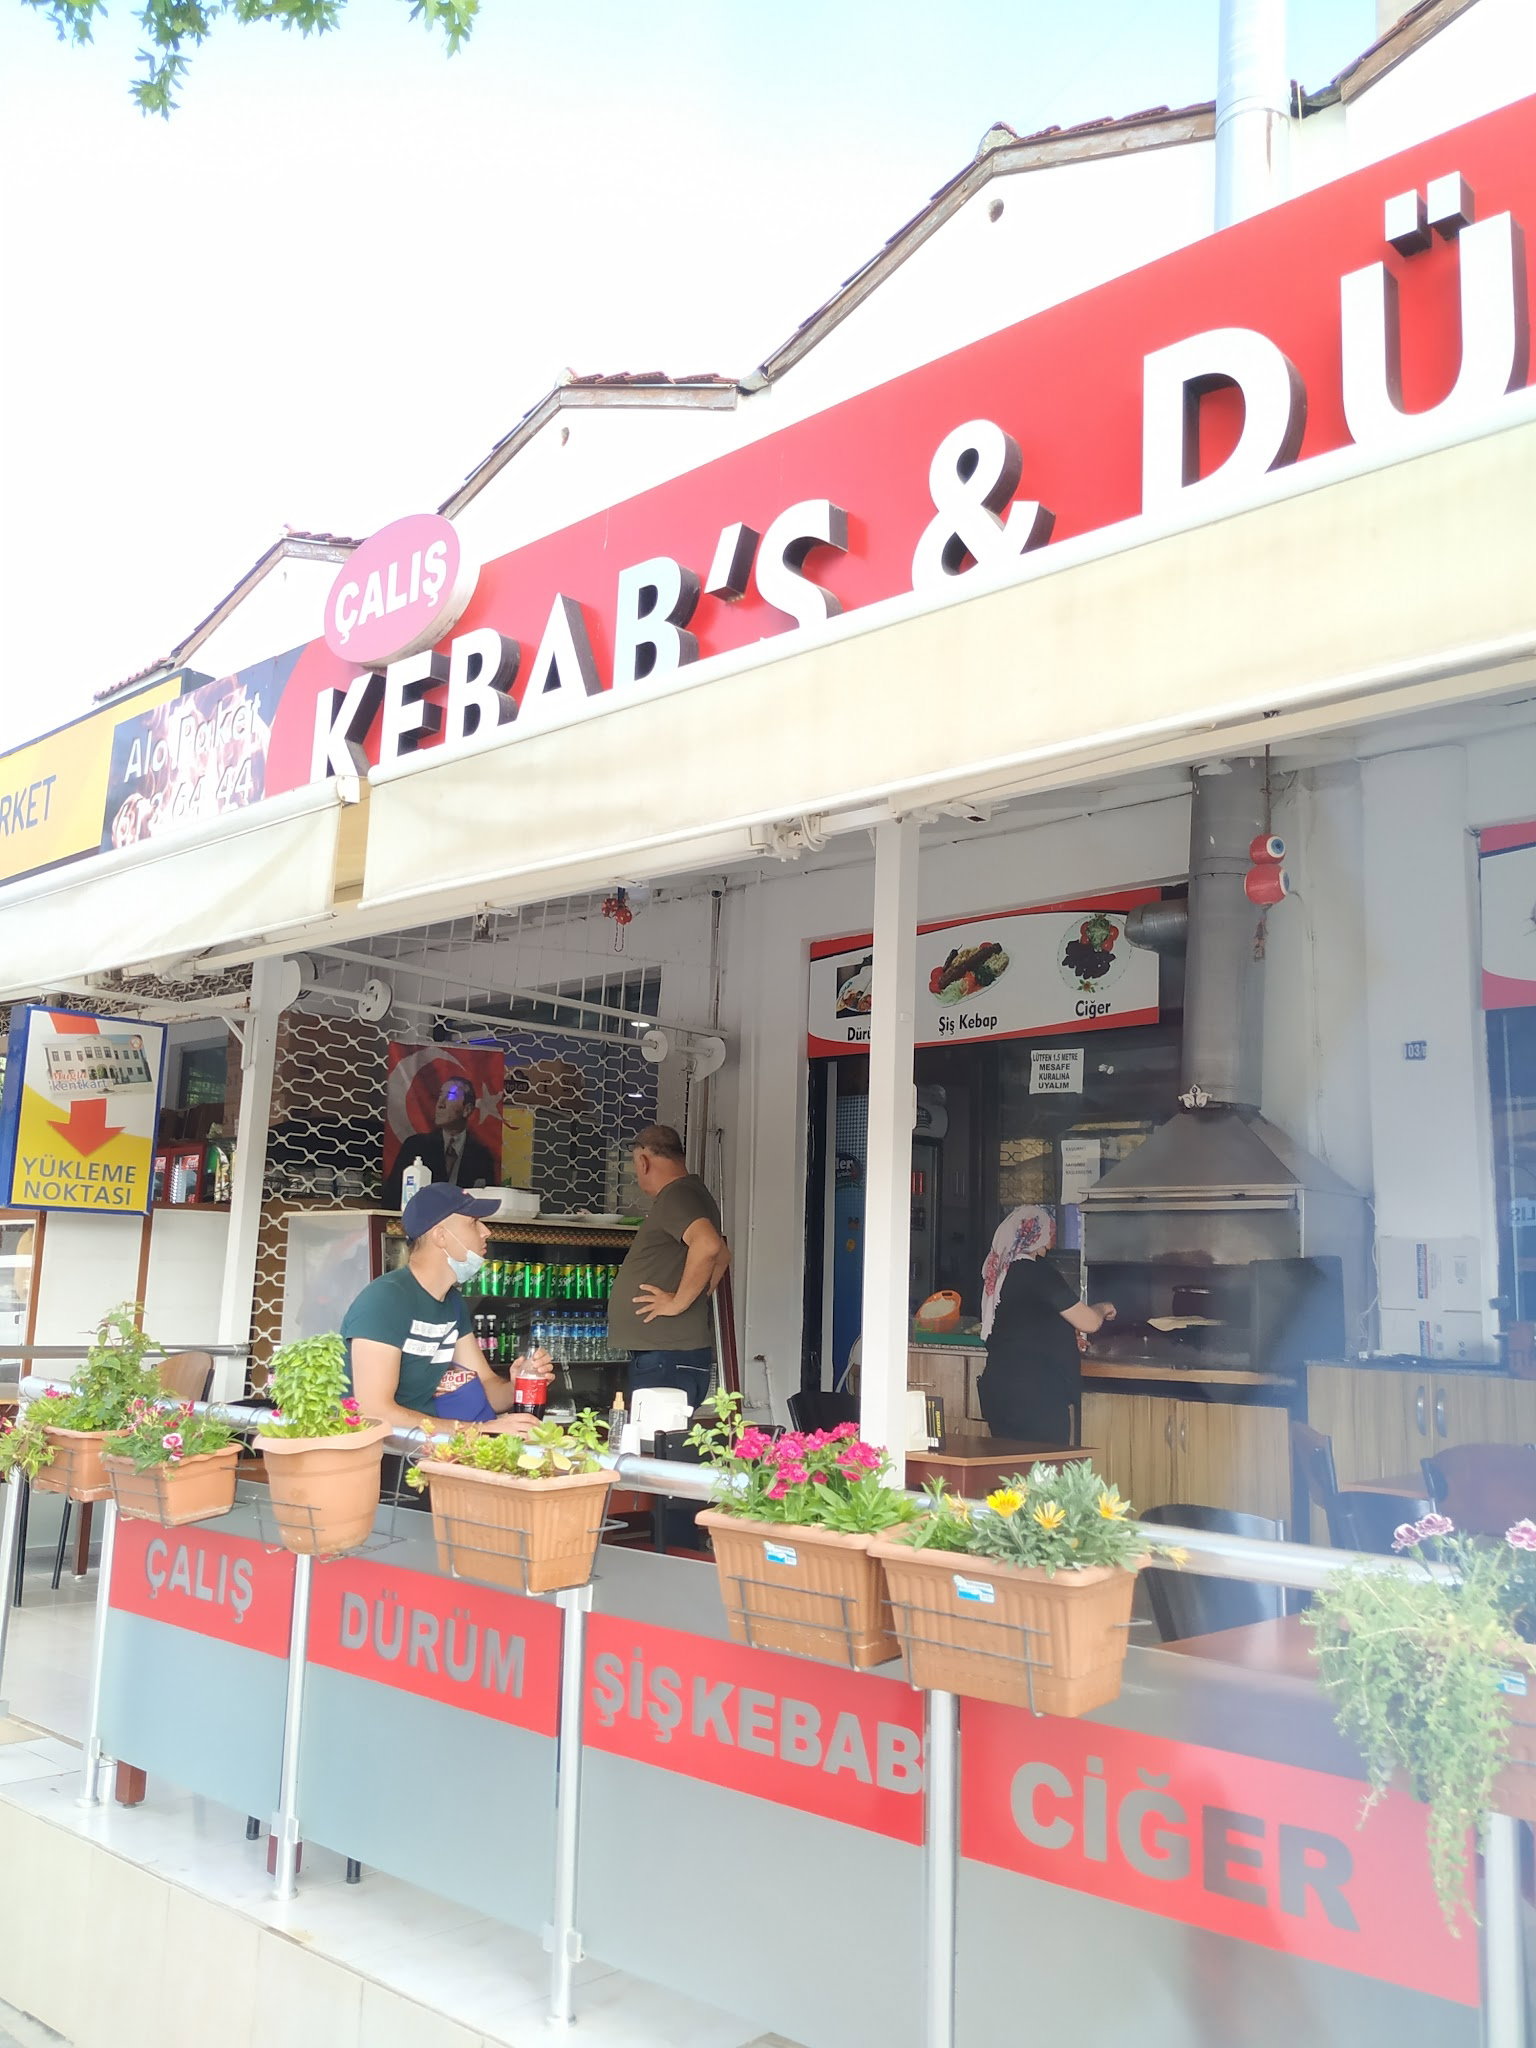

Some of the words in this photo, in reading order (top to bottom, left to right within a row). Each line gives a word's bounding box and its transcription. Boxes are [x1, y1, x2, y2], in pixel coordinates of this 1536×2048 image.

[910, 418, 1056, 592] &
[334, 539, 448, 646] ÇALIŞ
[124, 729, 168, 783] Alo
[173, 692, 262, 769] Paket
[216, 757, 254, 813] 44
[938, 1016, 955, 1035] Şiş
[959, 1013, 998, 1032] Kebap
[1075, 1000, 1111, 1019] Ciğer
[1032, 1053, 1052, 1062] LÜTFEN
[1061, 1053, 1078, 1061] METRE
[1038, 1073, 1070, 1081] KURALINA
[1039, 1063, 1071, 1071] MESAFE
[23, 1154, 137, 1184] YÜKLEME
[24, 1181, 131, 1206] NOKTASI
[145, 1538, 254, 1624] ÇALIŞ
[340, 1588, 526, 1699] DÜRÜM
[1010, 1756, 1360, 1934] CİĞER
